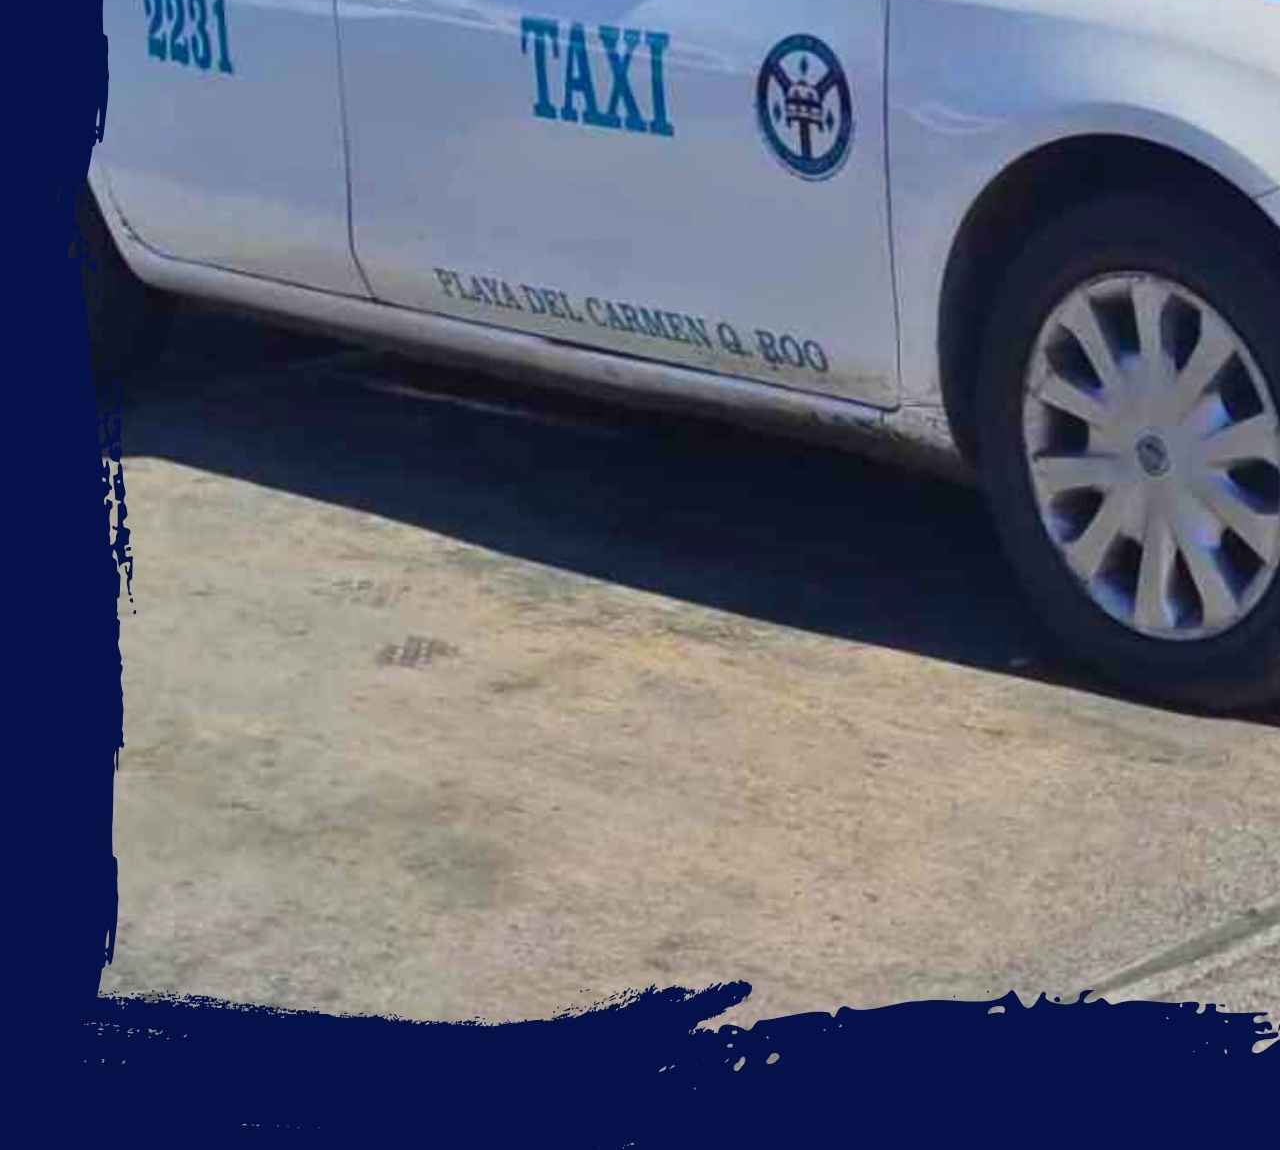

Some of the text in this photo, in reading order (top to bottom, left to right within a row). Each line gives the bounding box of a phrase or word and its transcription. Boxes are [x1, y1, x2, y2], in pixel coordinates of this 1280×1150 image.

[521, 17, 674, 137] TAXI
[434, 268, 522, 310] PLAYA
[521, 284, 584, 323] DEL
[586, 297, 713, 349] CARMEN
[755, 329, 829, 373] ROO
